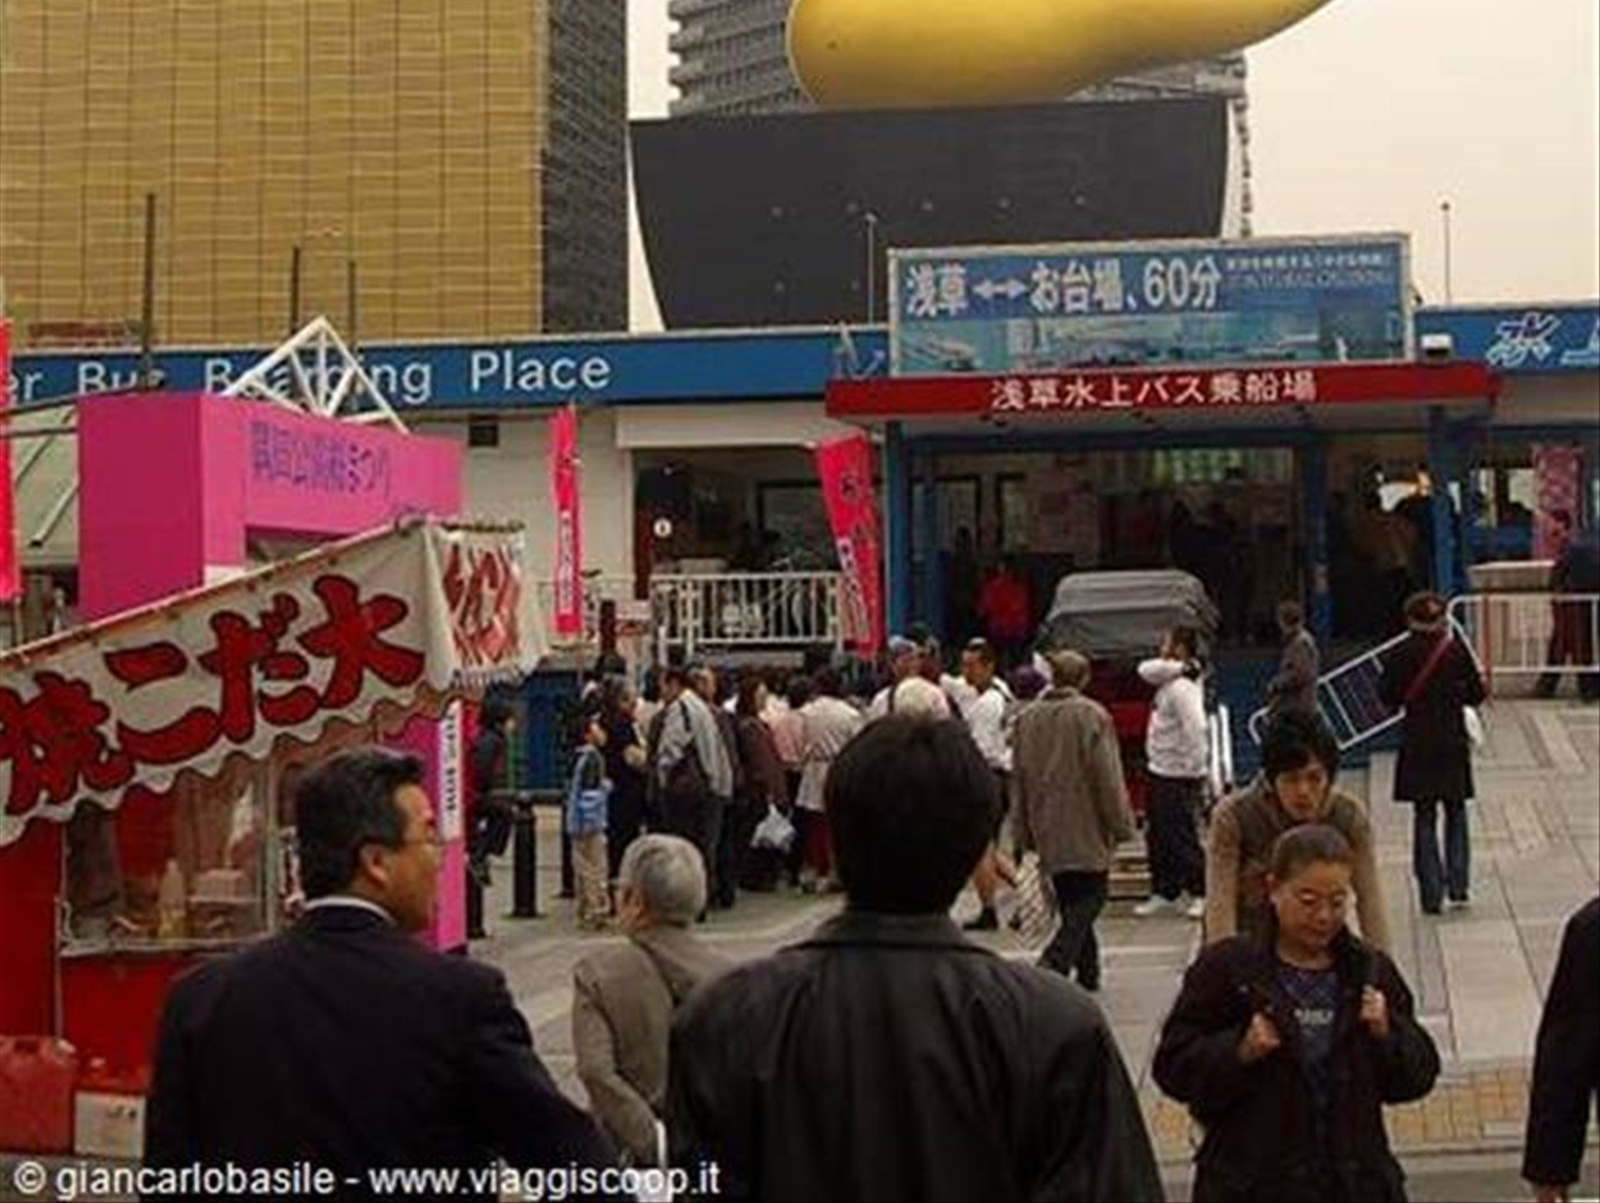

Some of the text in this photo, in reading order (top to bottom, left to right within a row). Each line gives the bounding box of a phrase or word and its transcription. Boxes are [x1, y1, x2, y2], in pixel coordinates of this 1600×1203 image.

[906, 260, 969, 317] 浅草
[470, 350, 611, 392] Place
[991, 369, 1317, 411] 浅草水上バス乗船場
